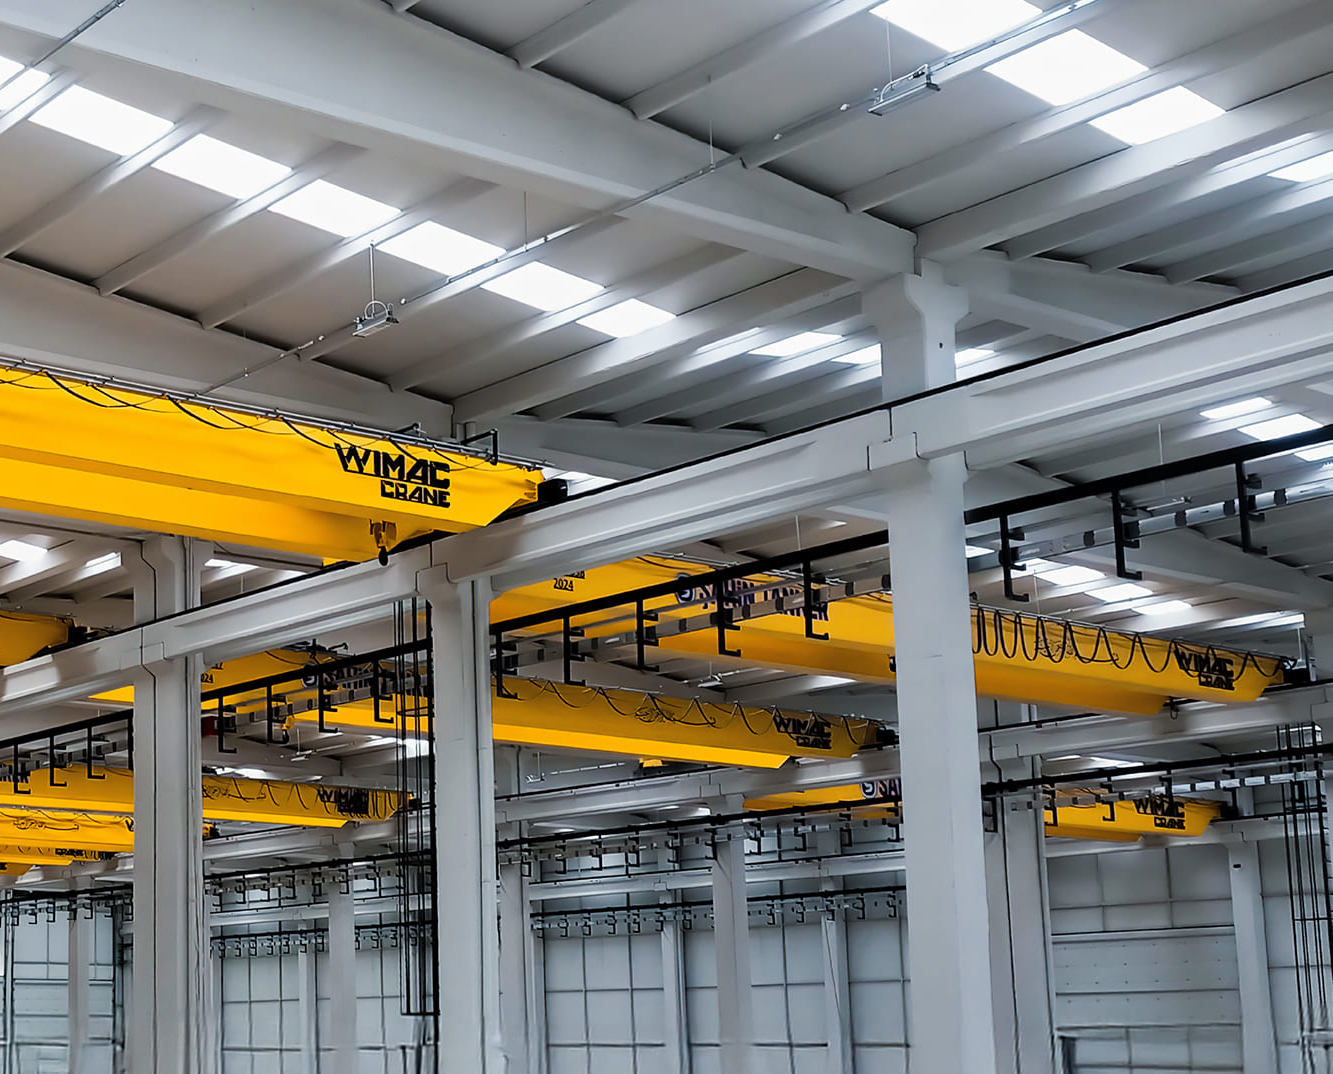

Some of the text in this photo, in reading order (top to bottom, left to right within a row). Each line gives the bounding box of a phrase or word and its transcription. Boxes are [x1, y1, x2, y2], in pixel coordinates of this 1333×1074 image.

[334, 442, 451, 489] WIMAC
[381, 479, 451, 508] CRANE
[553, 577, 574, 592] 2024
